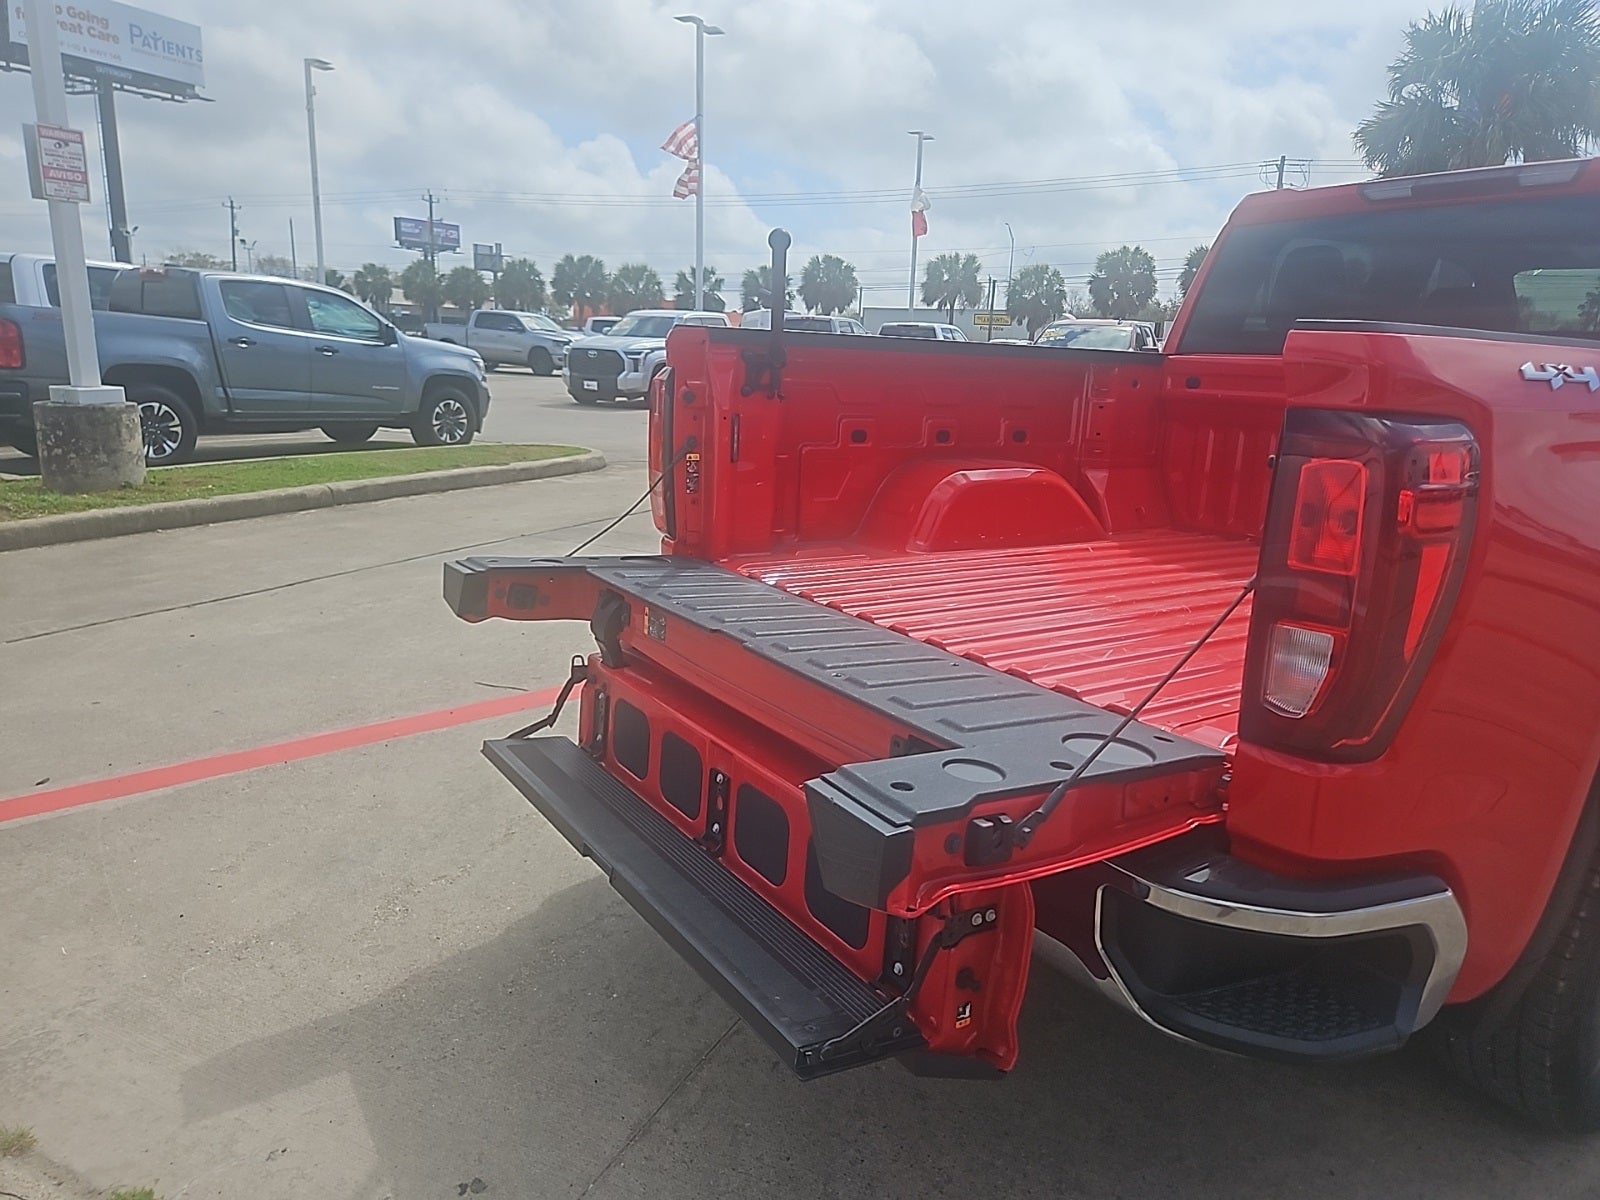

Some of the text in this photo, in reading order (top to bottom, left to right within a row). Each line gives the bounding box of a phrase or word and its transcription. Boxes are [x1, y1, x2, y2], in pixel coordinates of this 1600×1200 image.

[66, 5, 110, 30] Going
[87, 26, 120, 45] Care
[49, 169, 82, 181] AVISO
